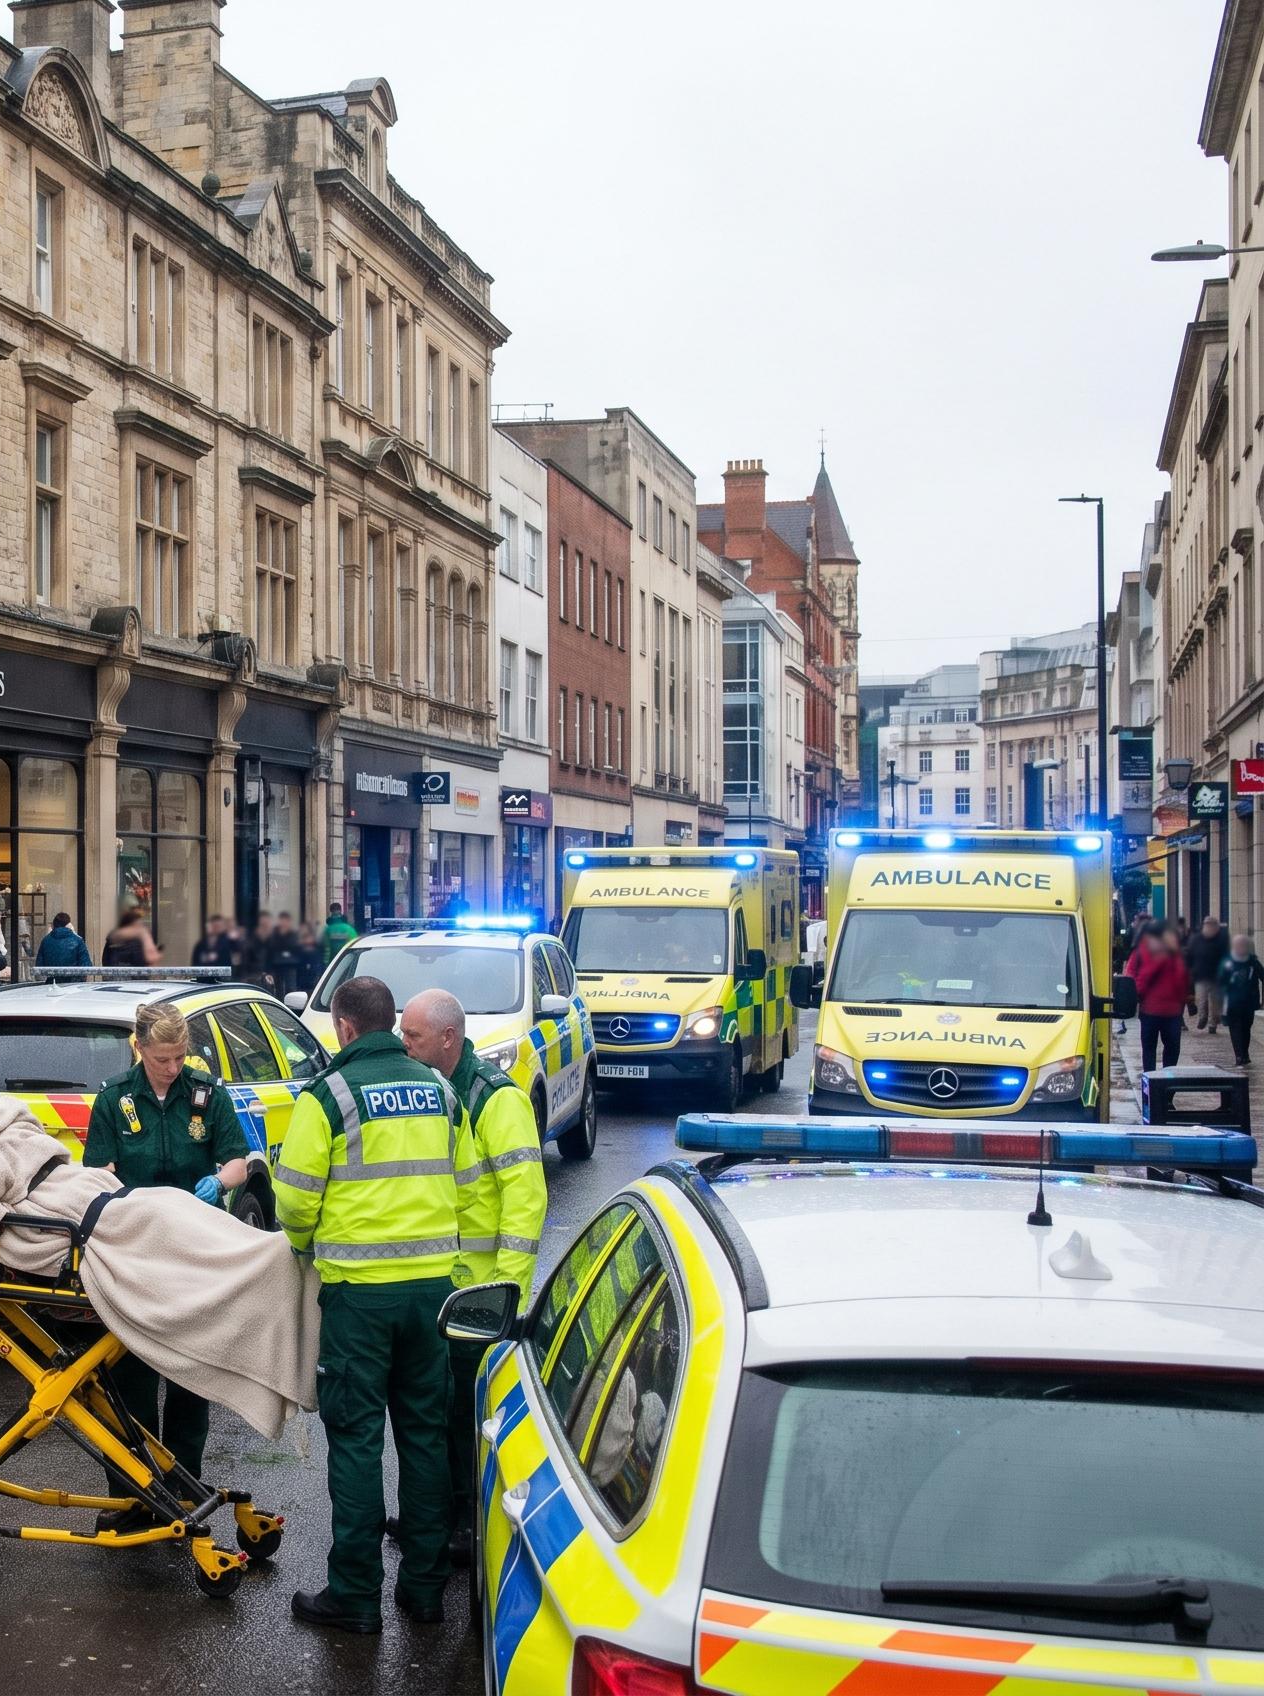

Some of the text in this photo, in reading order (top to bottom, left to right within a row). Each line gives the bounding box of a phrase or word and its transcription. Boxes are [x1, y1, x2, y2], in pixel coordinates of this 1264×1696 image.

[870, 870, 1051, 890] AMBULANCE
[589, 887, 711, 898] AMBULANCE
[368, 1089, 439, 1113] POLICE
